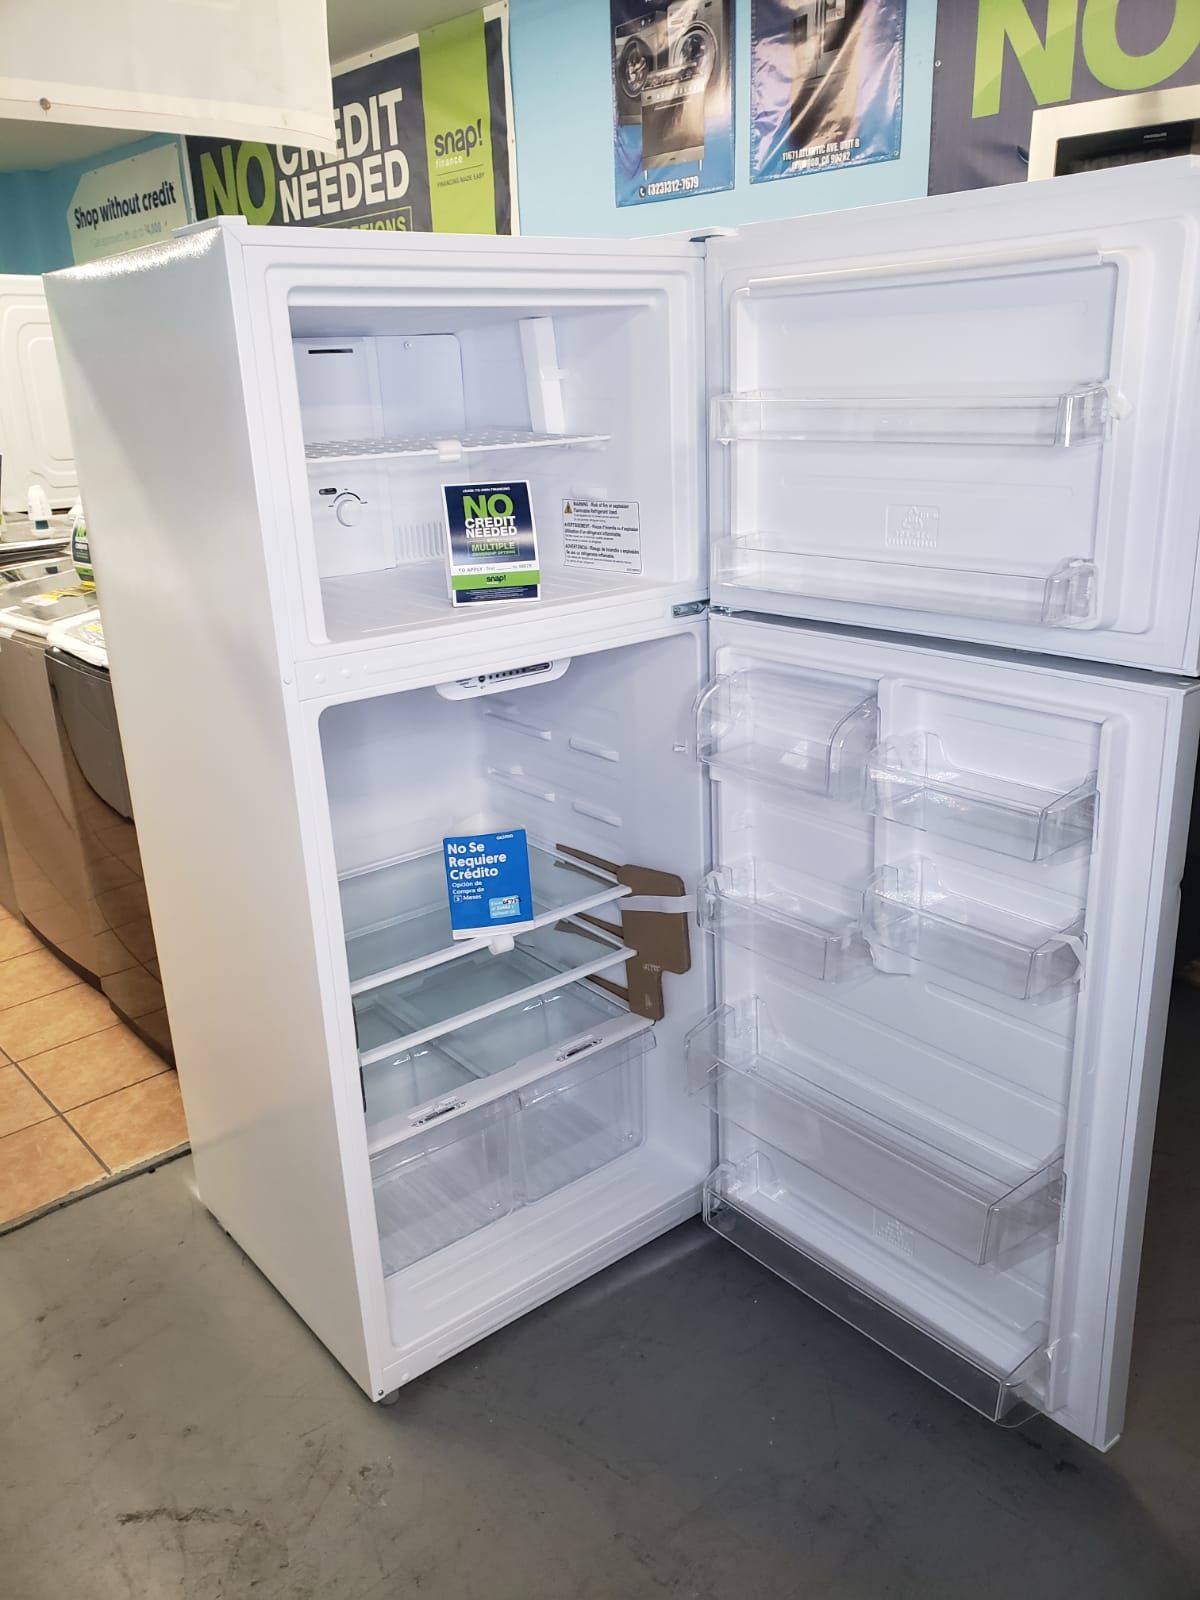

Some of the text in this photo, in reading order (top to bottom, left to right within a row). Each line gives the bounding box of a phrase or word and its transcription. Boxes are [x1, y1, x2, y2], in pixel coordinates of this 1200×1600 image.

[971, 0, 1200, 119] NO
[434, 118, 483, 157] snap!
[200, 140, 276, 225] NO
[279, 149, 410, 223] NEEDED
[74, 180, 177, 230] Shop without credit
[463, 493, 514, 519] NO
[465, 516, 516, 529] CREDIT
[466, 526, 518, 538] NEEDED
[471, 542, 516, 552] MULTIPLE
[486, 574, 507, 583] snap!
[447, 841, 485, 855] No Se
[448, 853, 507, 869] Requiere
[450, 867, 499, 880] Crédito
[452, 881, 473, 889] Opción
[452, 888, 476, 896] Compra
